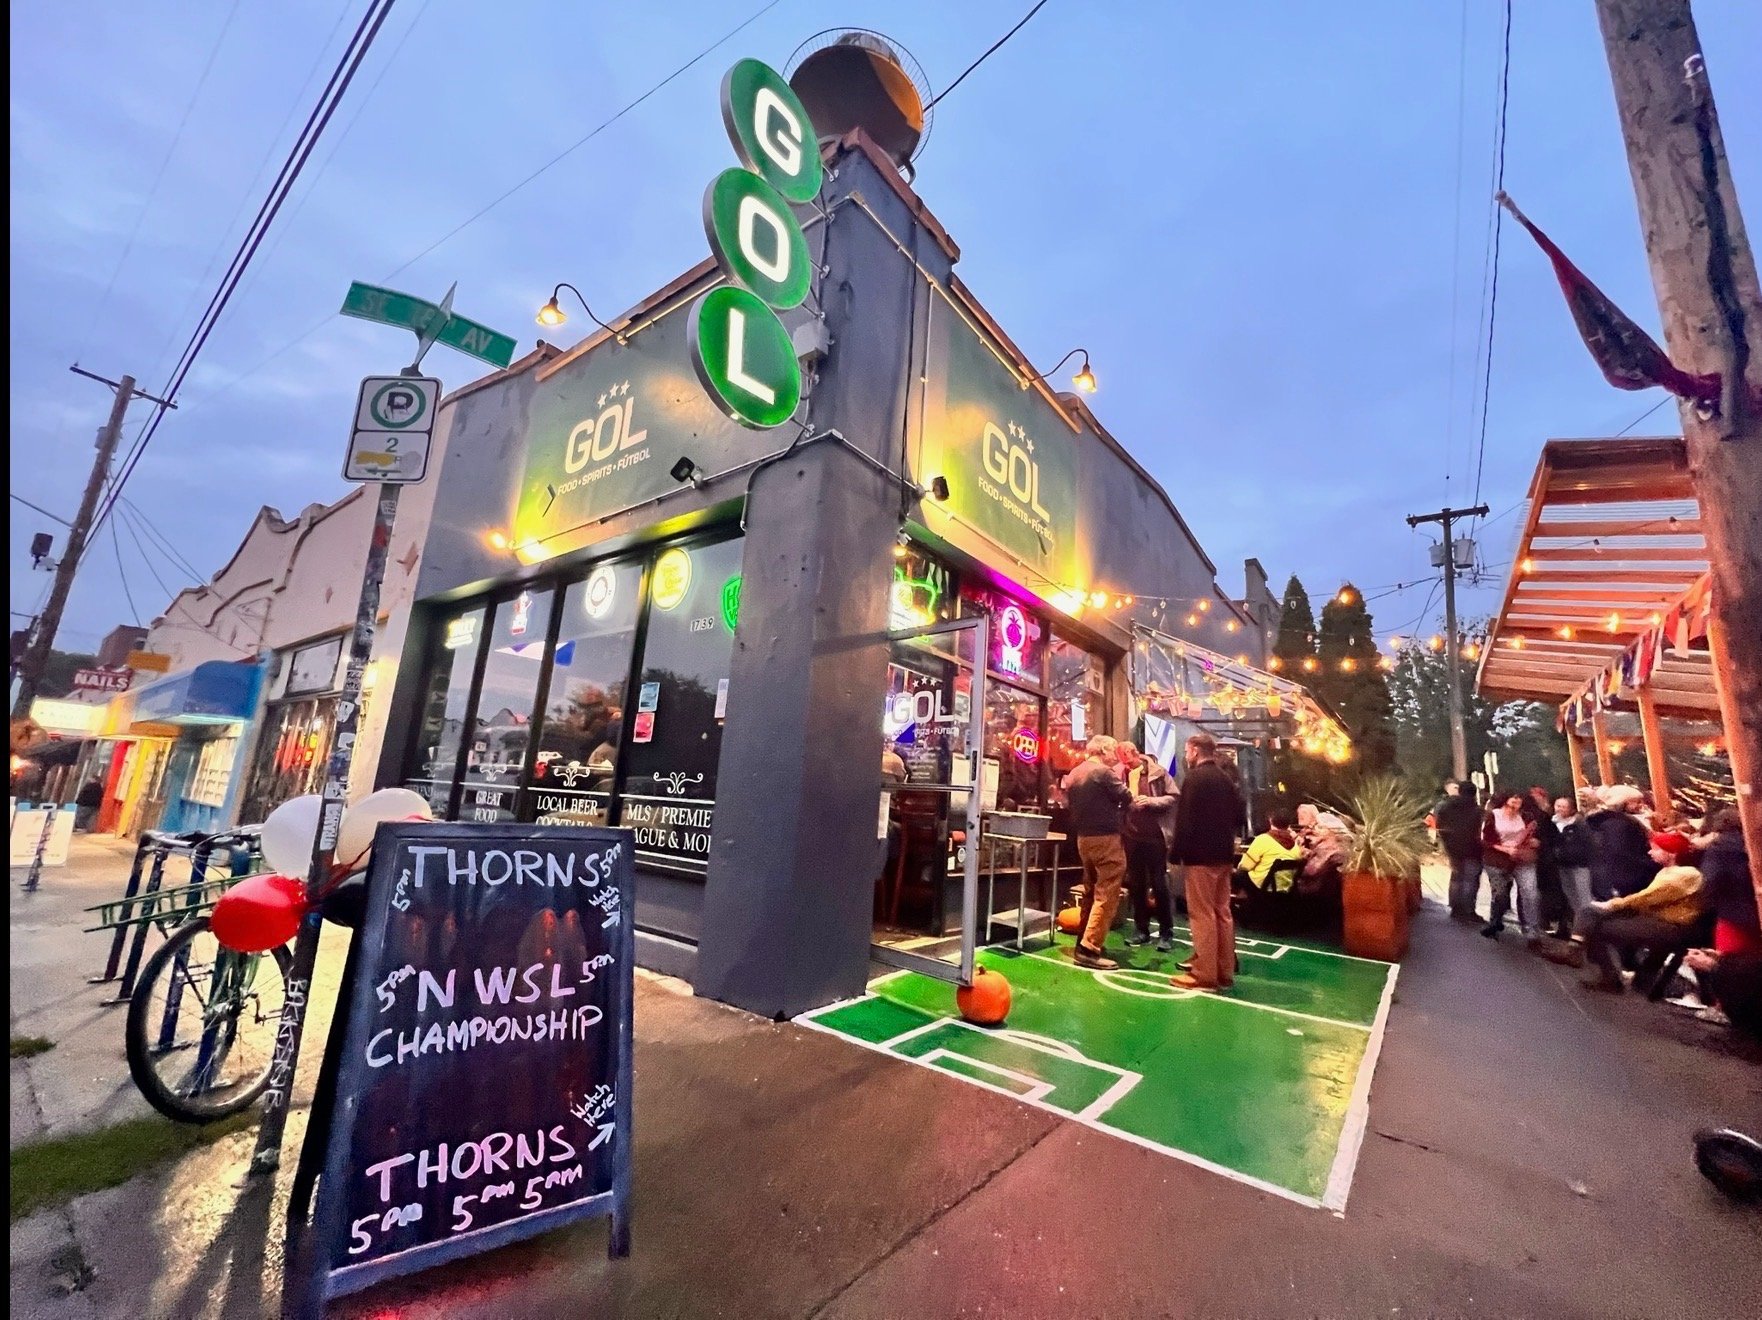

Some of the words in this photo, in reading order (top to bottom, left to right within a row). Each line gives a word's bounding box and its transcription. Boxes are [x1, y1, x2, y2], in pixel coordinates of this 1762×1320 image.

[727, 87, 803, 406] GOL
[461, 328, 493, 353] AV
[385, 437, 399, 453] 2
[557, 479, 579, 496] FOOD
[581, 463, 613, 486] SPIRITS
[978, 476, 999, 501] FOOD
[1002, 496, 1029, 524] SPIRITS
[690, 617, 714, 632] 1739
[74, 672, 129, 690] NAILS
[1014, 733, 1039, 758] OPEN
[475, 790, 503, 807] GREAT
[536, 795, 568, 812] LOCAL
[570, 798, 598, 816] BEER
[474, 807, 498, 823] FOOD
[627, 803, 652, 822] MLS
[668, 830, 680, 849] &
[408, 845, 600, 888] THORNS
[366, 1004, 604, 1068] CHAMPIONSHIP
[570, 1084, 611, 1119] Watch
[365, 1124, 577, 1202] THORNS
